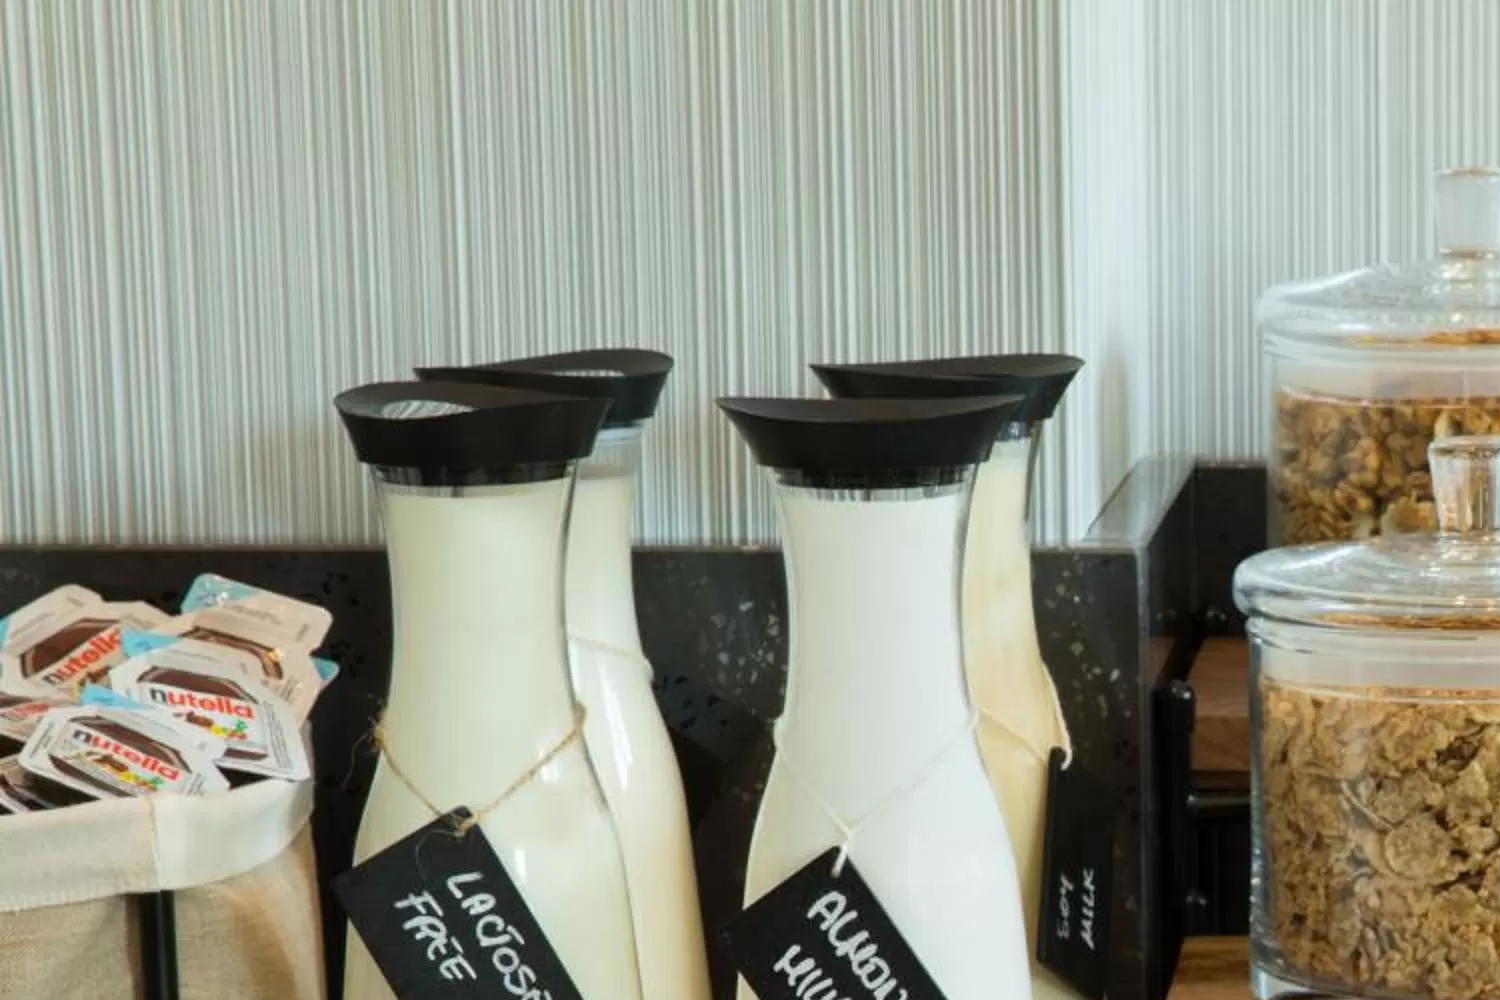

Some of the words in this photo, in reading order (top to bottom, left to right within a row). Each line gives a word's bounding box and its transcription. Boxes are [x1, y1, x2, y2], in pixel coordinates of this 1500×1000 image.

[151, 688, 254, 718] nutella
[73, 729, 181, 780] nutella
[395, 890, 476, 982] FREE
[1081, 867, 1095, 950] MILK
